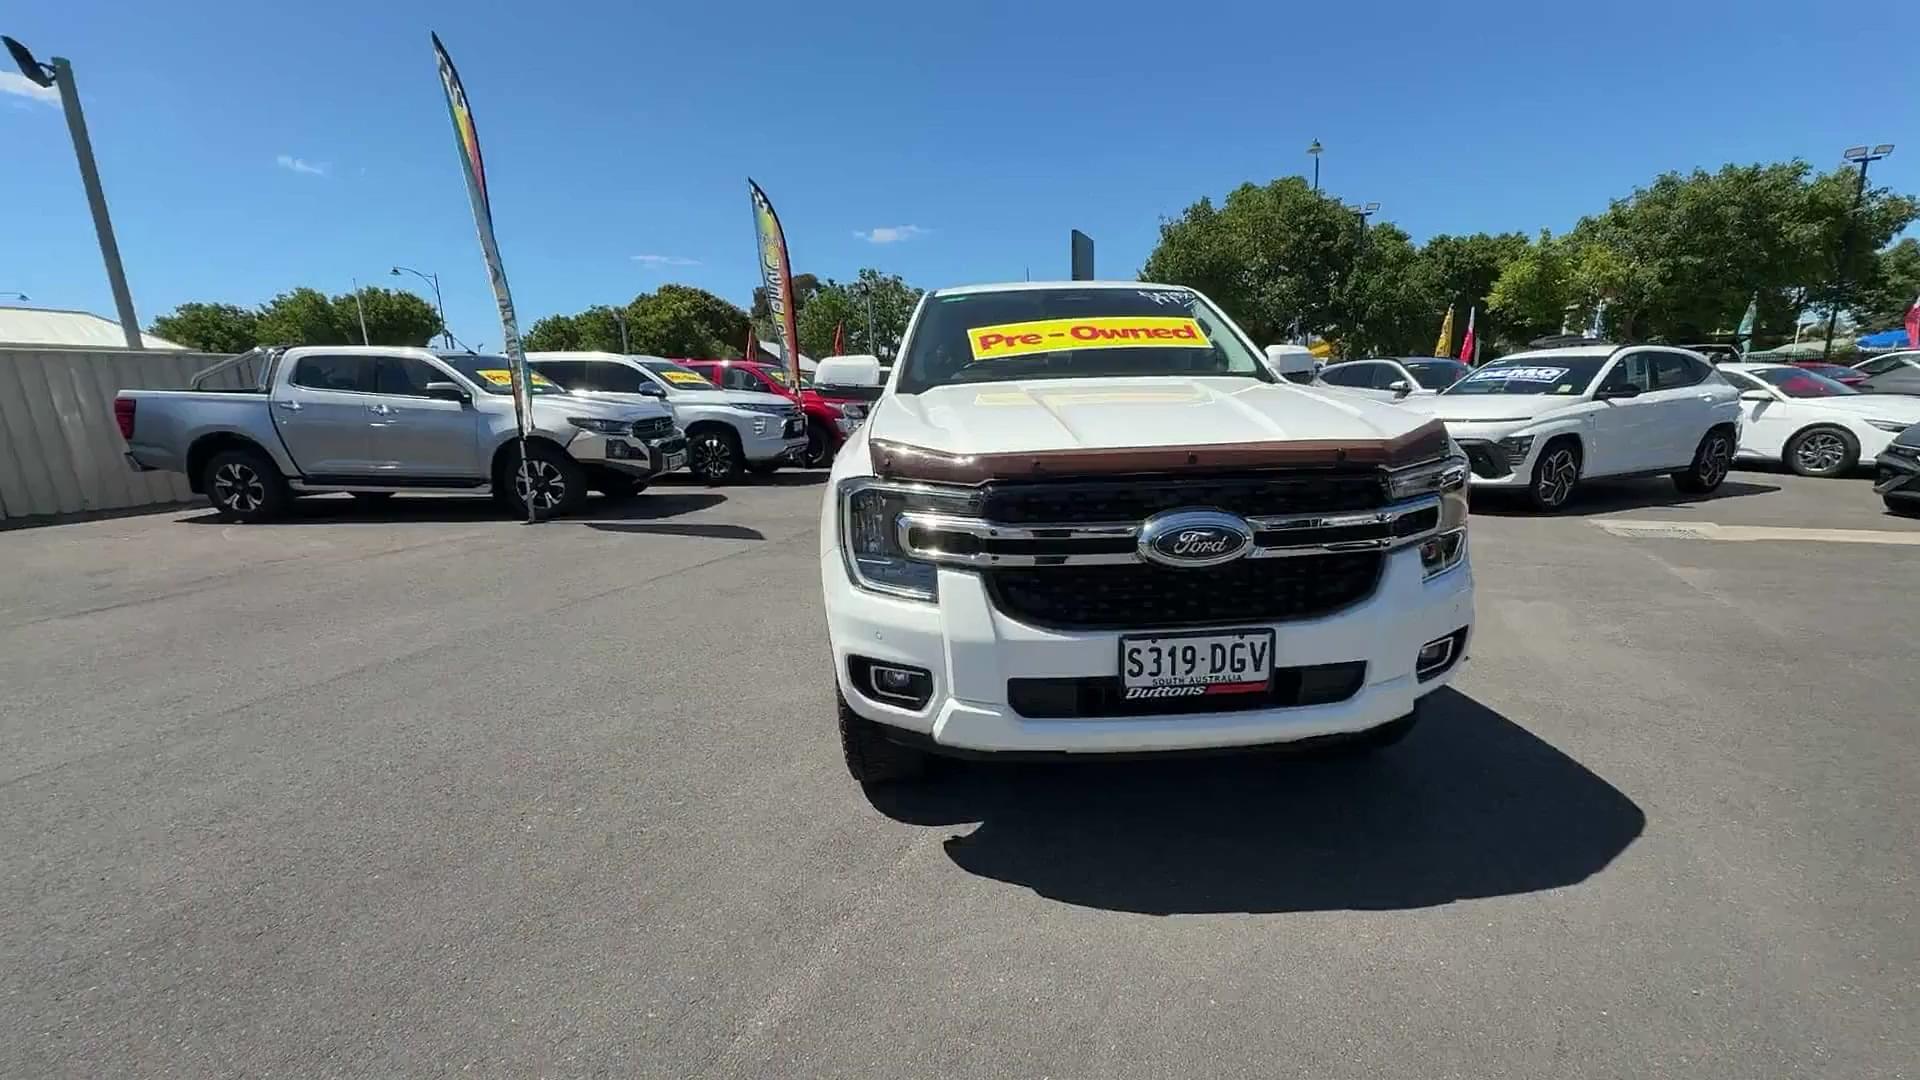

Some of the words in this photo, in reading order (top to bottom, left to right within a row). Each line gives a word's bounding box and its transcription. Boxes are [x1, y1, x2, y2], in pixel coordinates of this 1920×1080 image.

[979, 333, 1042, 350] Pre
[1070, 325, 1197, 341] Owned
[1174, 530, 1229, 554] Ford
[1152, 677, 1185, 687] SOUTH
[1189, 674, 1243, 685] AUSTRALIA
[1126, 685, 1206, 699] Duttons
